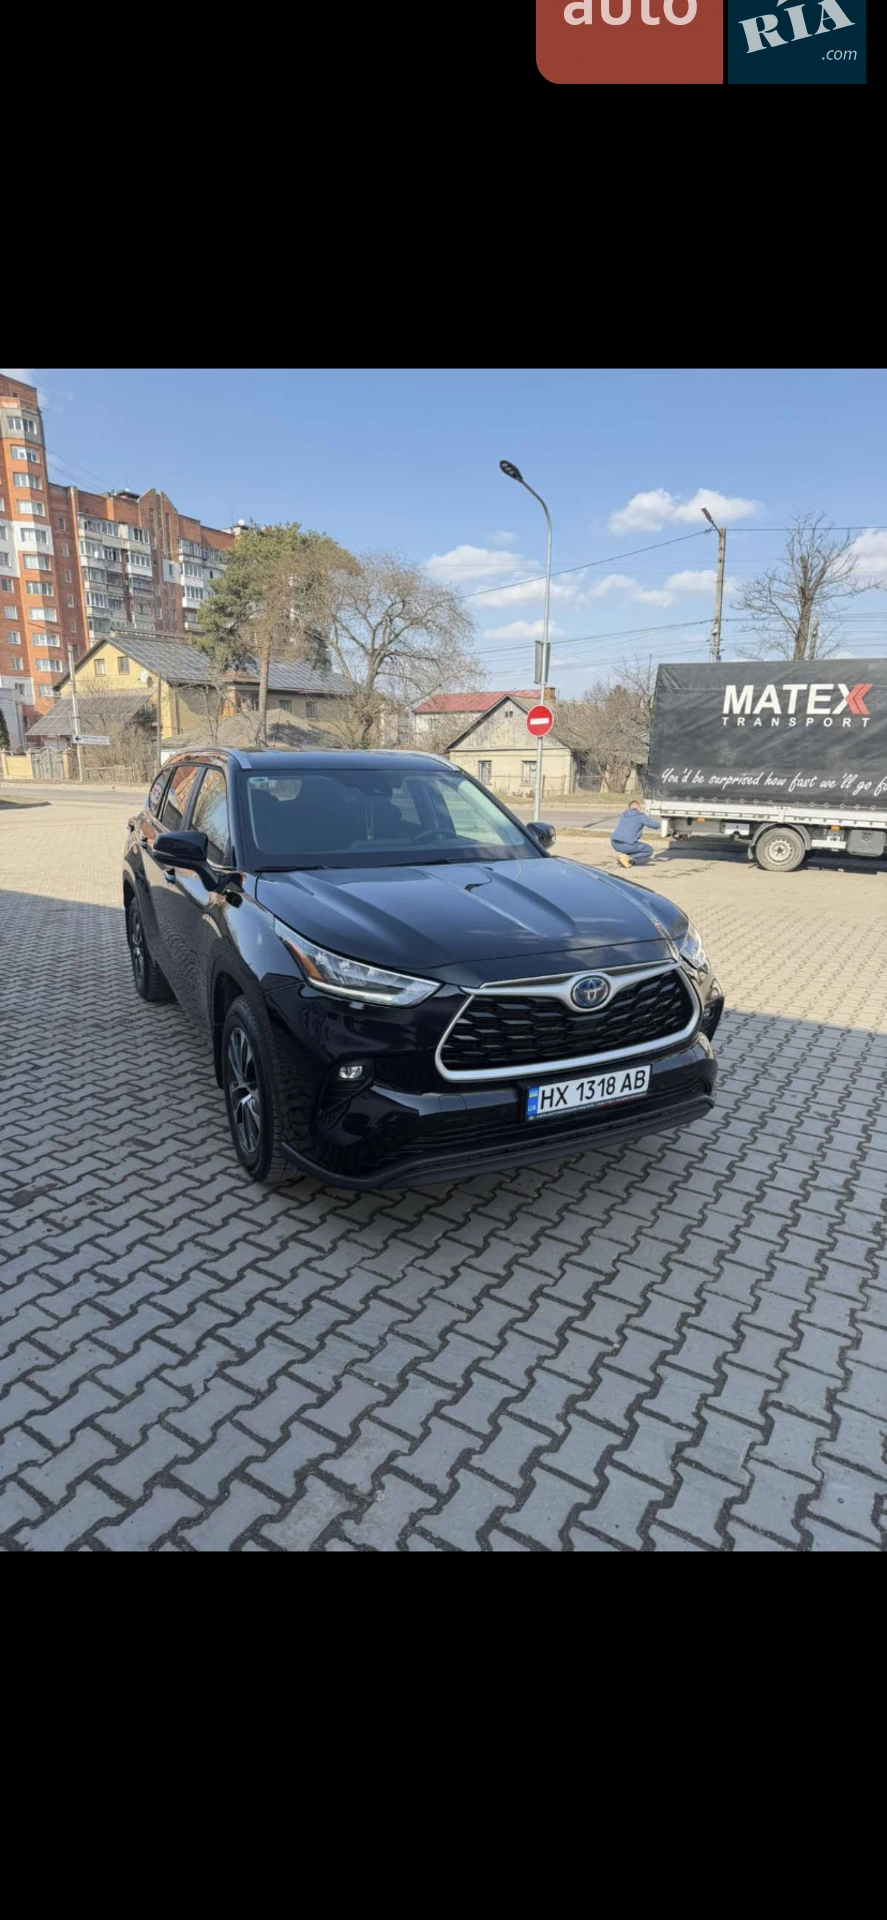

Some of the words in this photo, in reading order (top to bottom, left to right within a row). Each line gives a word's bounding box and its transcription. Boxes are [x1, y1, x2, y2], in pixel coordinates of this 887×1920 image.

[722, 683, 874, 716] MATEX
[722, 716, 871, 728] TRANSPORT
[661, 767, 693, 784] You'd
[691, 769, 705, 784] be
[708, 771, 765, 790] surprised
[764, 771, 788, 786] how
[788, 772, 819, 793] fast
[853, 781, 873, 795] go
[540, 1085, 569, 1110] HX
[576, 1076, 616, 1102] 1318
[620, 1070, 646, 1093] AB
[527, 1104, 536, 1112] UA
